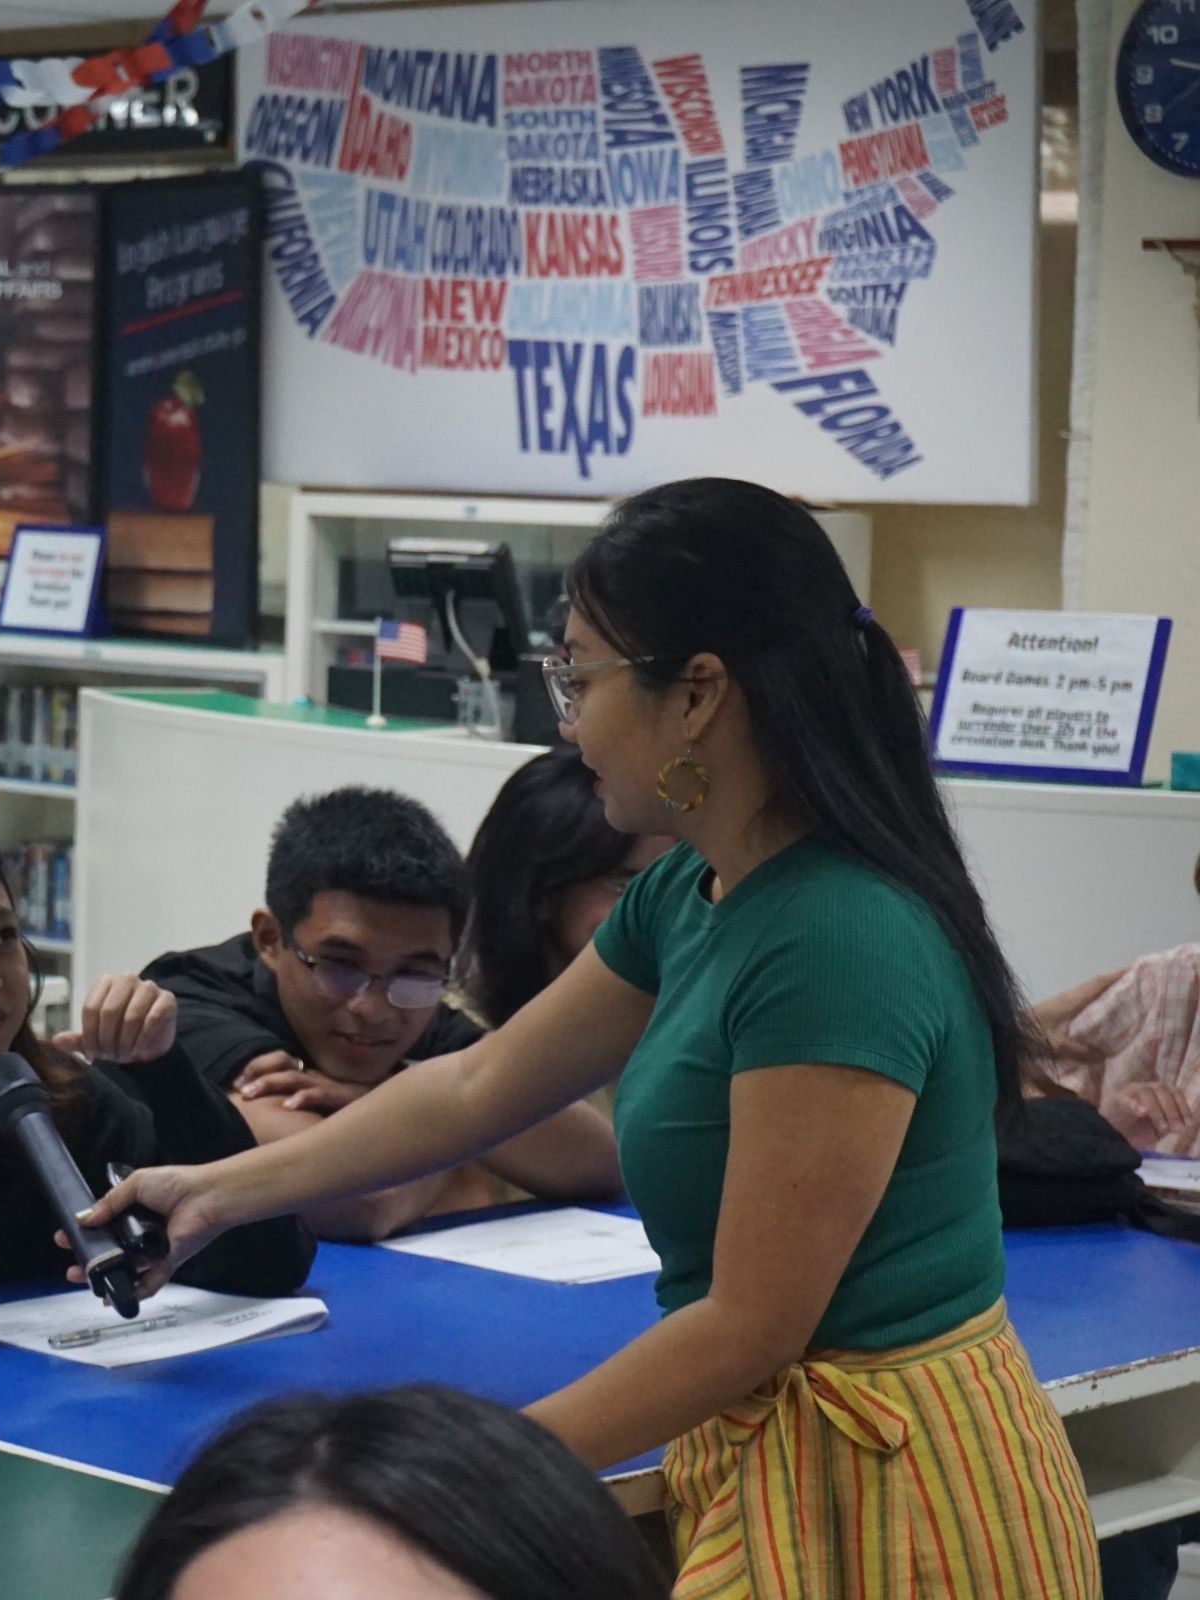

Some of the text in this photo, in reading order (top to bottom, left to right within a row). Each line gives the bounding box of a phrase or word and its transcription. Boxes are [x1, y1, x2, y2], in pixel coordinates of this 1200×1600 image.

[1147, 24, 1178, 44] 10
[503, 50, 593, 75] NORTH
[363, 47, 498, 127] MONTANA
[504, 75, 597, 106] DAKOTA
[871, 53, 941, 125] YORK
[246, 95, 348, 168] OREGON
[504, 109, 597, 129] SOUTH
[1171, 132, 1189, 151] 7
[507, 131, 600, 162] DAKOTA
[605, 149, 681, 207] IOWA
[363, 189, 428, 273] UTAH
[685, 158, 734, 273] ILLINOIS
[818, 204, 935, 252] VIRGINIA
[525, 211, 624, 278] KANSAS
[424, 278, 508, 324] NEW
[421, 326, 505, 371] MEXICO
[507, 339, 638, 480] TEXAS
[770, 369, 924, 481] FLORIDA
[1007, 631, 1099, 655] Attention!
[1055, 673, 1065, 689] 2
